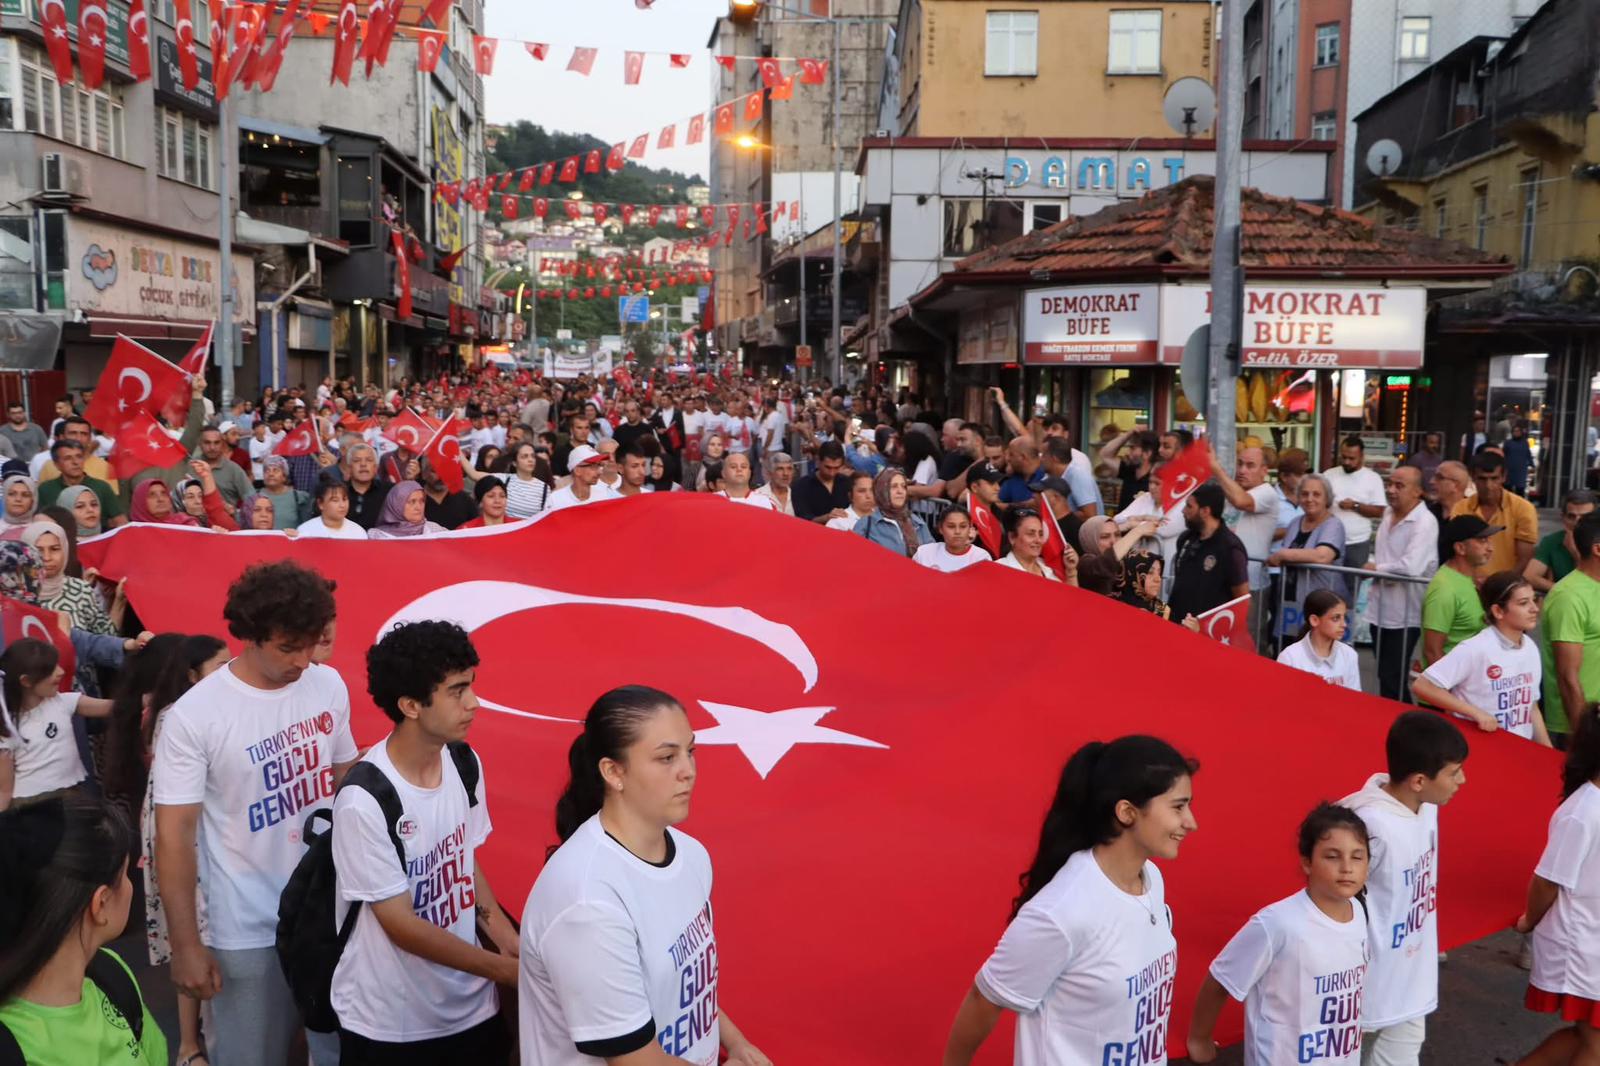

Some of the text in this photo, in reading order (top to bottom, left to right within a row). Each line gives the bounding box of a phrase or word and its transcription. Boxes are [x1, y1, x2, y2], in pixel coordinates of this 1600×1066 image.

[1005, 154, 1184, 189] DAMAT
[131, 247, 174, 278] DERYA
[139, 286, 173, 305] ÇOCUK
[1041, 293, 1140, 314] DEMOKRAT
[1205, 291, 1385, 316] MOKRAT
[1067, 313, 1111, 335] BÜFE
[1254, 316, 1335, 345] BÜFE
[1246, 350, 1338, 365] Salih ÖZER
[263, 740, 319, 791] GÜCÜ
